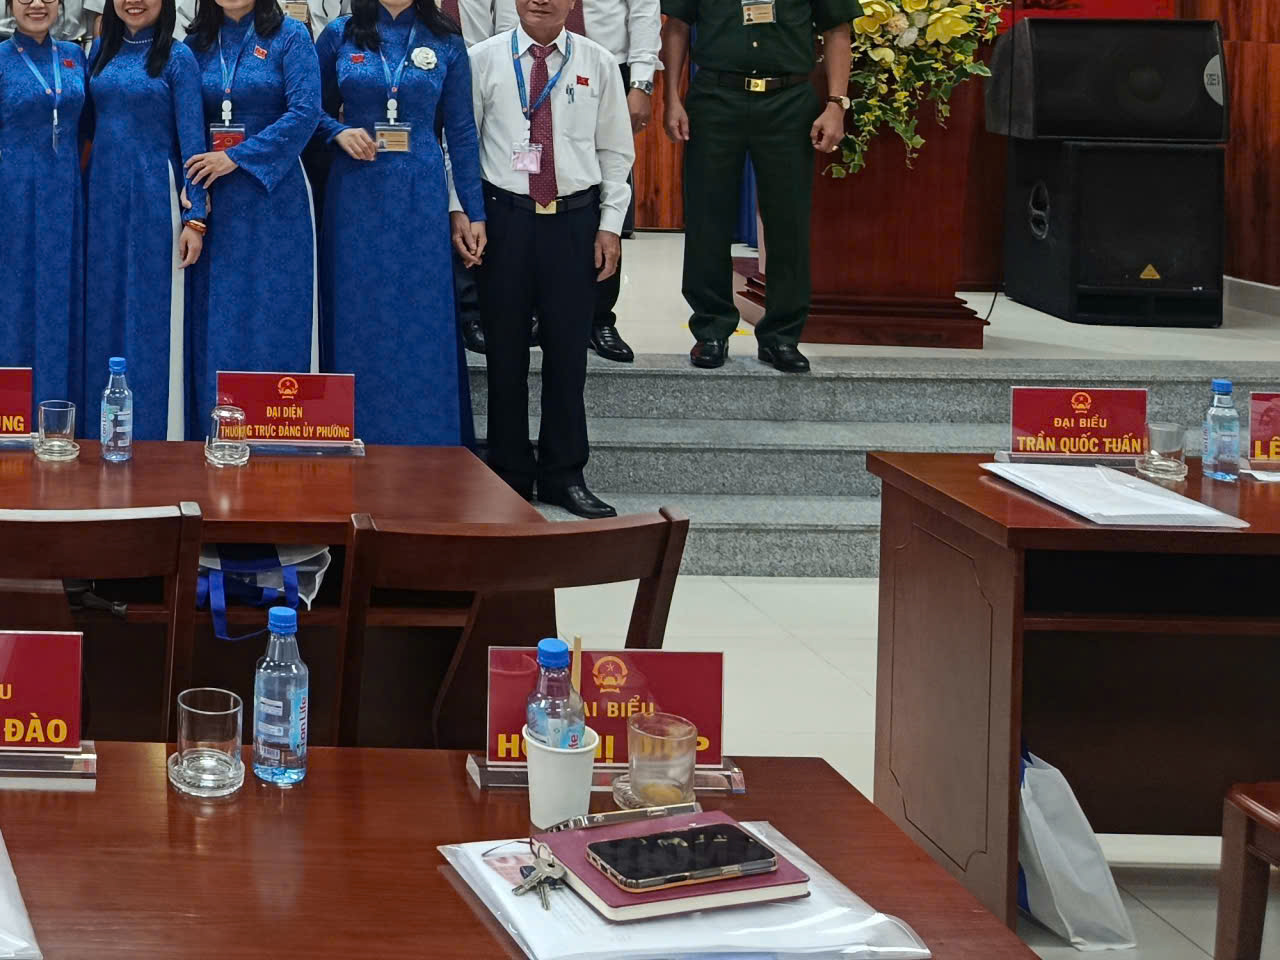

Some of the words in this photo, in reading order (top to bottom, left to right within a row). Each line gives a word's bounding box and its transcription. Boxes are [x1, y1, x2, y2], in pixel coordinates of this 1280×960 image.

[267, 406, 281, 419] ĐẠI
[283, 404, 303, 419] DIỆN
[254, 424, 276, 438] TRỰC
[278, 421, 300, 437] ĐẢNG
[303, 421, 314, 437] ỦY
[316, 423, 350, 438] PHƯỜNG
[1054, 418, 1074, 430] ĐẠI
[1080, 414, 1107, 429] BIỂU
[1017, 430, 1056, 452] TRẦN
[1060, 432, 1098, 455] QUỐC
[1103, 432, 1141, 453] TUẤN
[607, 695, 655, 718] BIỂU
[3, 711, 68, 743] ĐÀO
